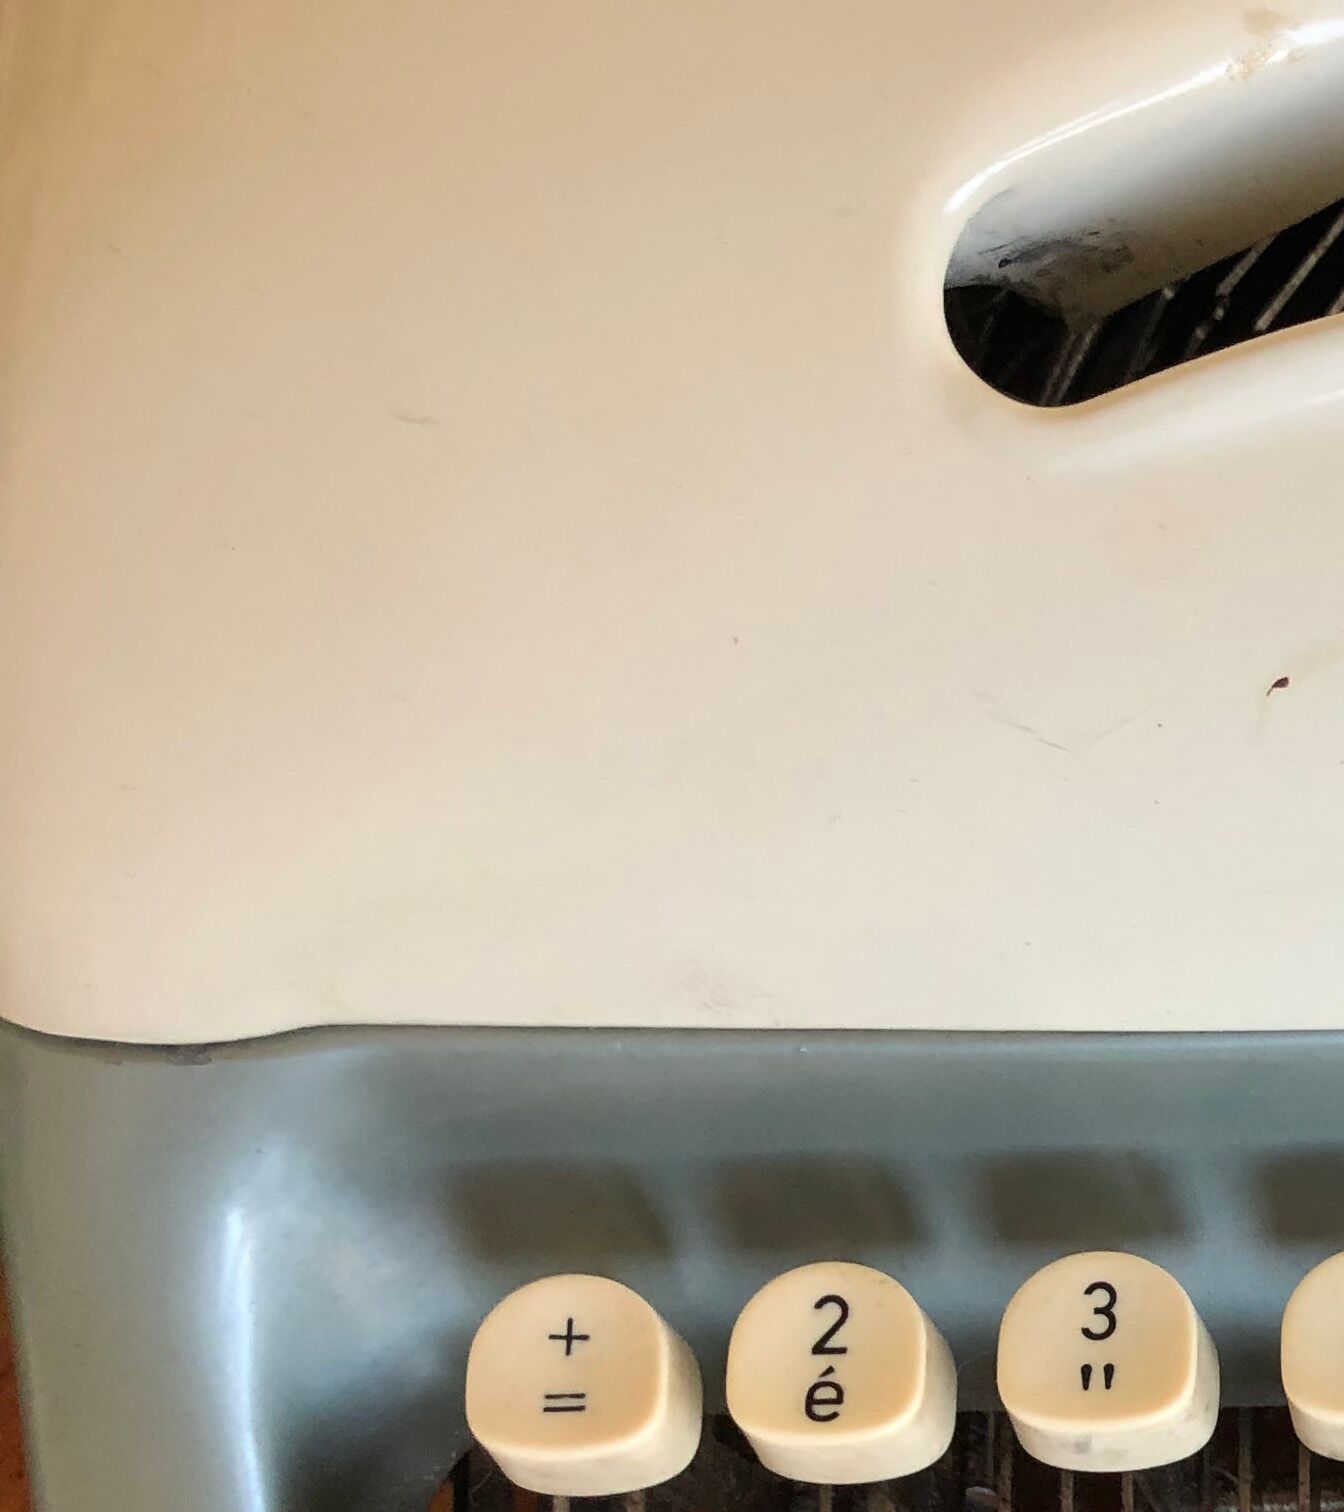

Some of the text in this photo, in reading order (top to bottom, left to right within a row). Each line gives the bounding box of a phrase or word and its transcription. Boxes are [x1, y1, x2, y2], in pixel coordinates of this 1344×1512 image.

[811, 1294, 850, 1356] 2
[1081, 1281, 1117, 1341] 3
[804, 1365, 845, 1423] é
